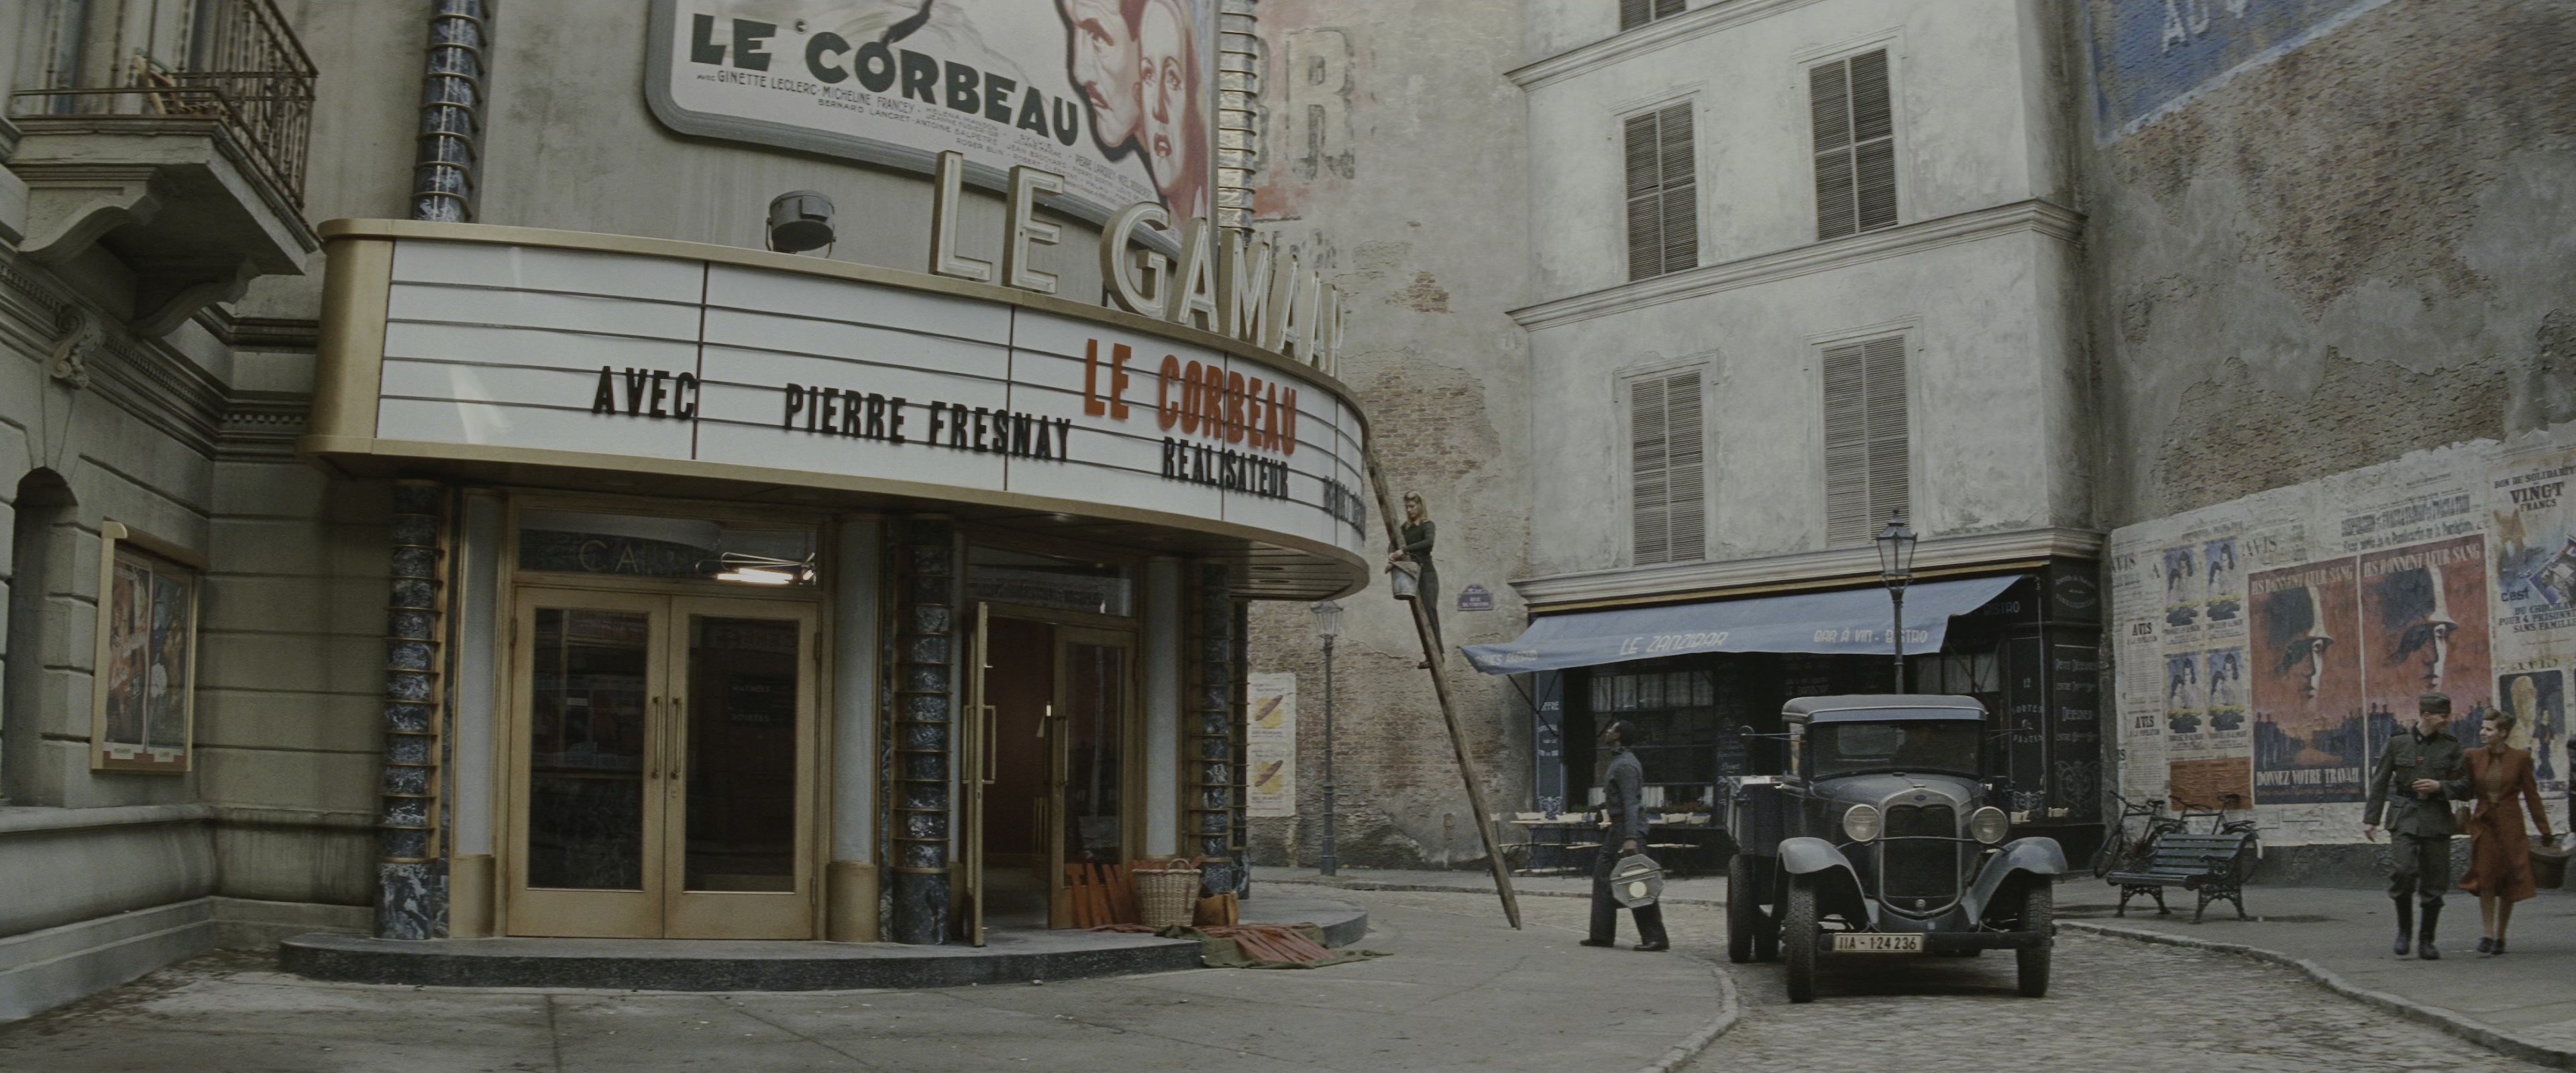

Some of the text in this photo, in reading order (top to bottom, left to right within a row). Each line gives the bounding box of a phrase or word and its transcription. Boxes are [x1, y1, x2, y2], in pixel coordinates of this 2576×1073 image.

[691, 13, 1079, 147] LE CORBEAU
[697, 70, 915, 114] AVEC GINETTE LECLERC MICHELINE FRANCEY
[818, 98, 865, 114] BERNARD
[869, 108, 911, 123] LANCRET
[955, 137, 983, 150] ROGER
[929, 150, 1065, 294] LE
[1084, 338, 1297, 455] LE CORBEAU
[591, 365, 1071, 463] AVEC PIERRE FRESNAY
[2510, 482, 2565, 504] VINGT
[2520, 498, 2557, 512] FRANCS
[2452, 543, 2481, 563] SANG
[1813, 629, 1837, 643] BAR
[1884, 629, 1928, 644] BSTRO
[2132, 622, 2153, 636] AVIS
[2514, 623, 2536, 633] SANS
[1619, 636, 1644, 656] LE
[2135, 715, 2155, 730] AVIS
[2256, 767, 2361, 786] DONNEZ VOTRE TRAVAIL
